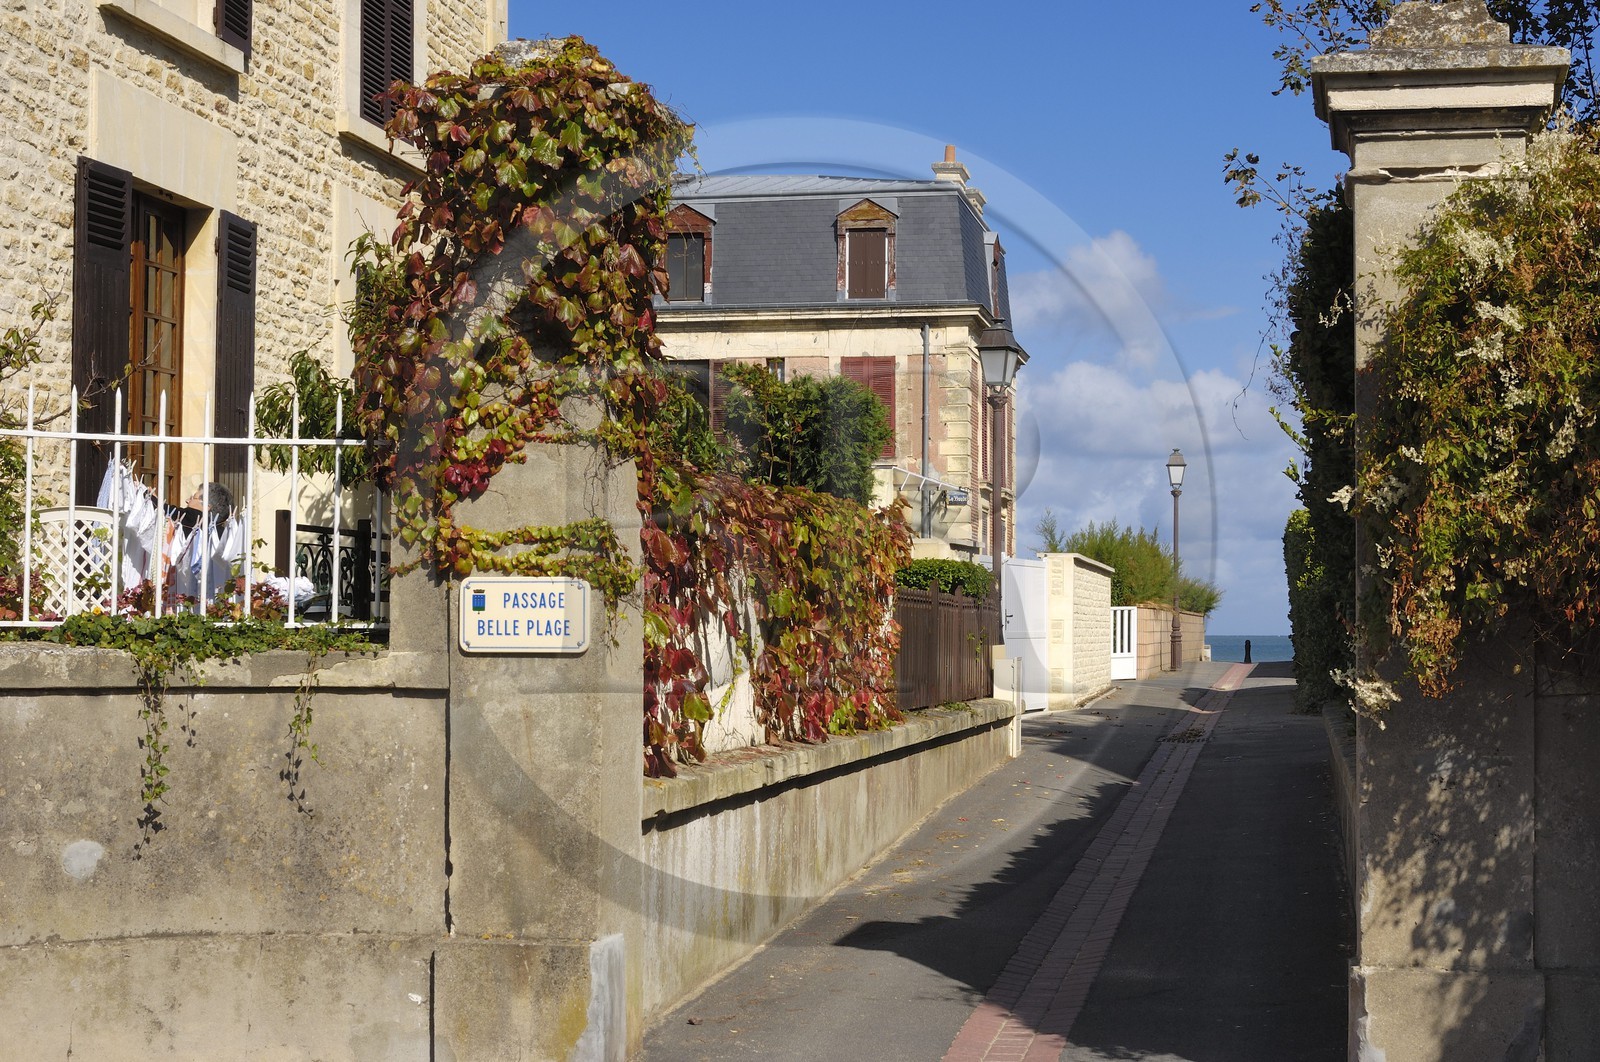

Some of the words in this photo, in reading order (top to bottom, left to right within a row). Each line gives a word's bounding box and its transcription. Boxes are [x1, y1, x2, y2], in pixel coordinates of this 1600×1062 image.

[503, 592, 565, 609] PASSAGE
[477, 619, 520, 636] BELLE
[527, 619, 571, 636] PLAGE
